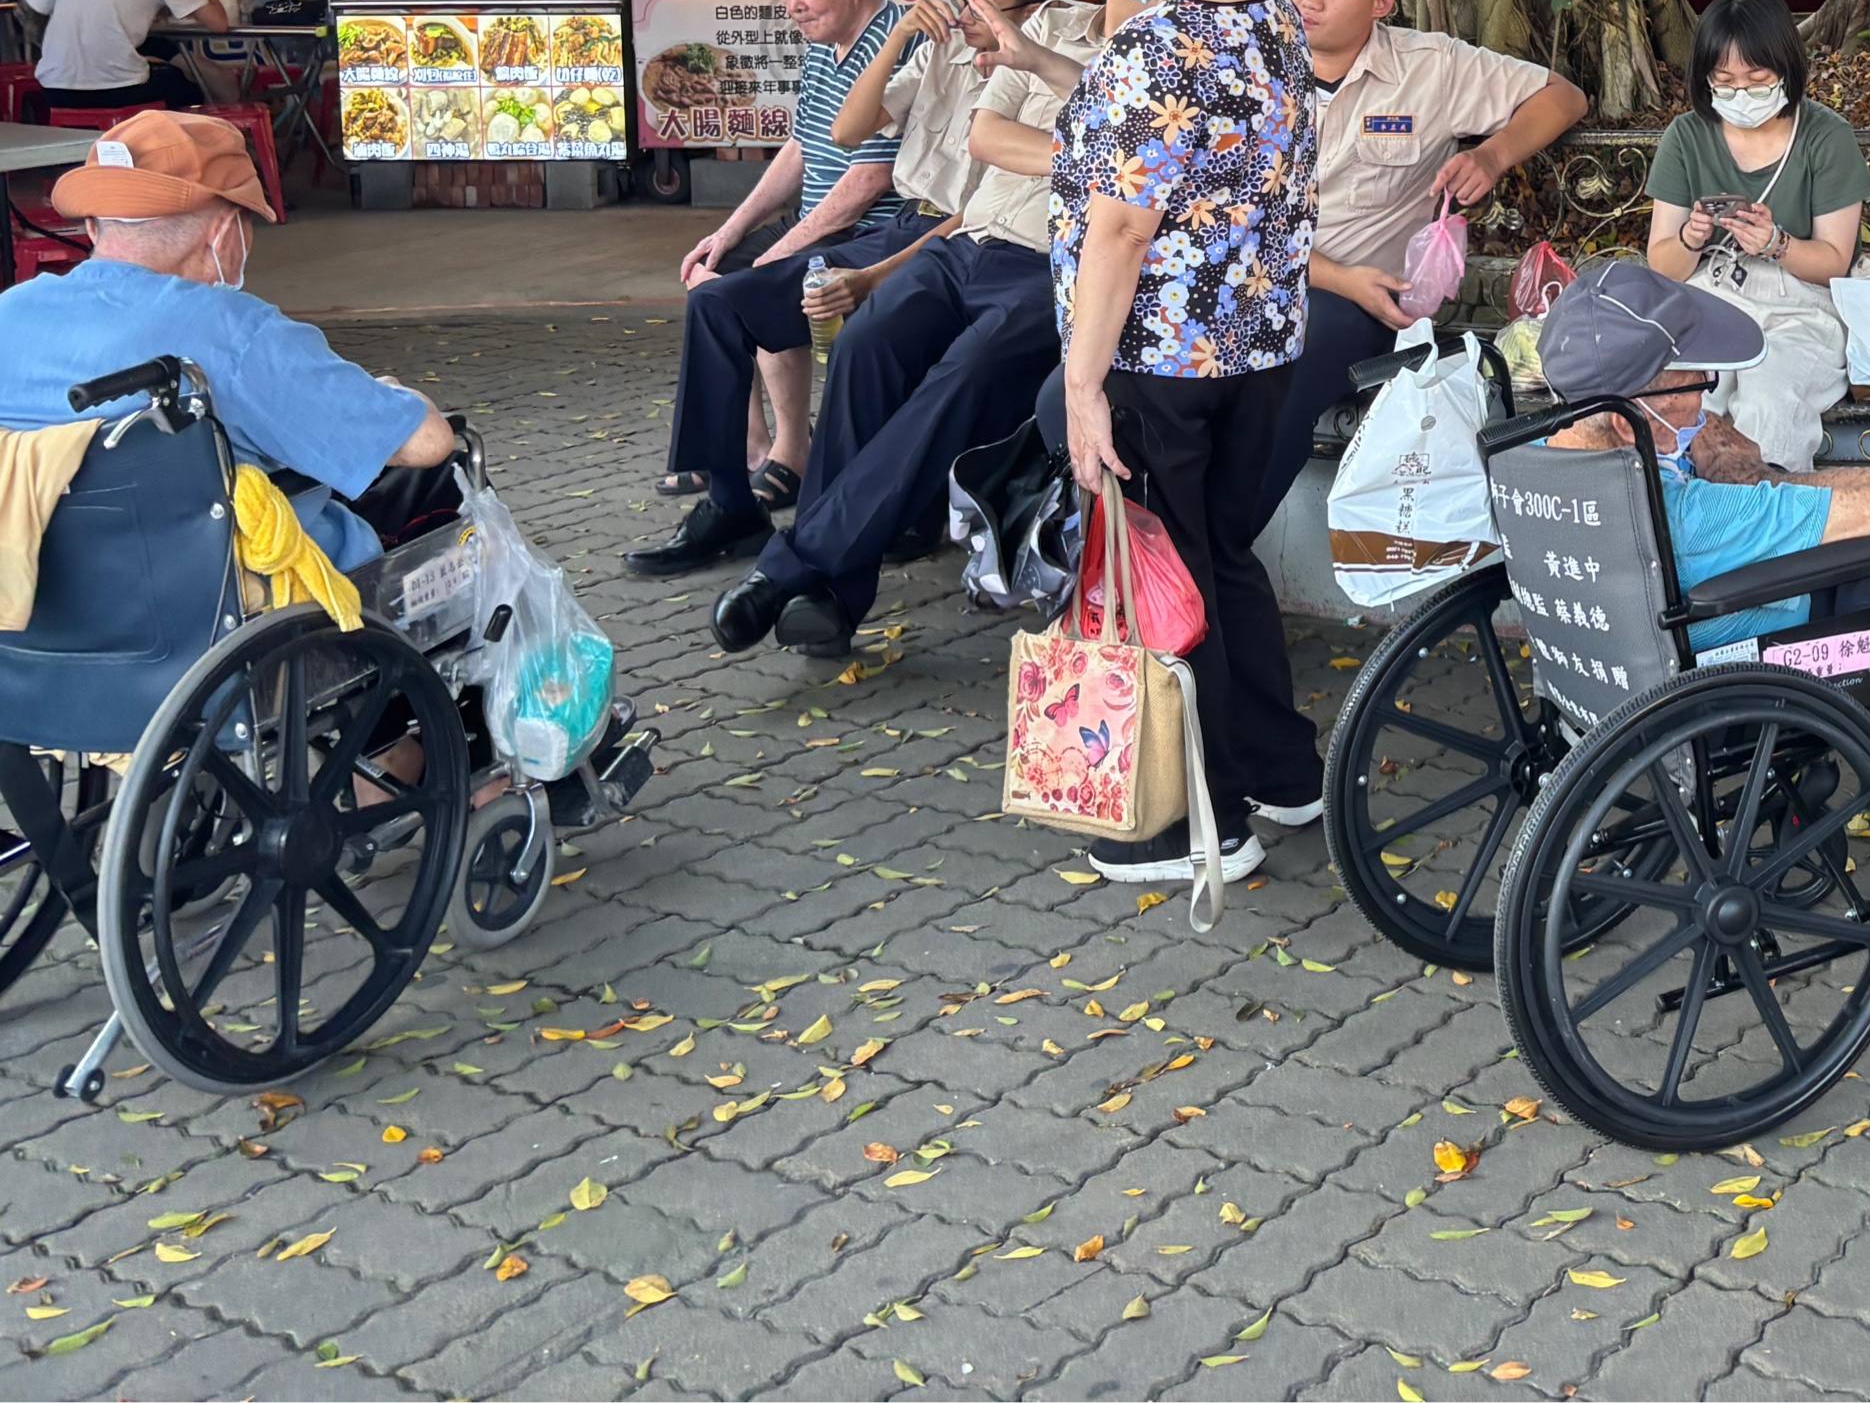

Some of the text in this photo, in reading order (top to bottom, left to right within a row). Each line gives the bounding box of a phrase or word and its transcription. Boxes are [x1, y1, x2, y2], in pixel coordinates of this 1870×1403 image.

[714, 5, 790, 21] 白色的麵皮
[715, 29, 812, 47] 從外型上就像
[659, 106, 790, 139] 大腸麵線
[1543, 550, 1602, 583] 黃進中
[1554, 598, 1610, 632] 蔡義德
[1782, 643, 1830, 667] G2-09
